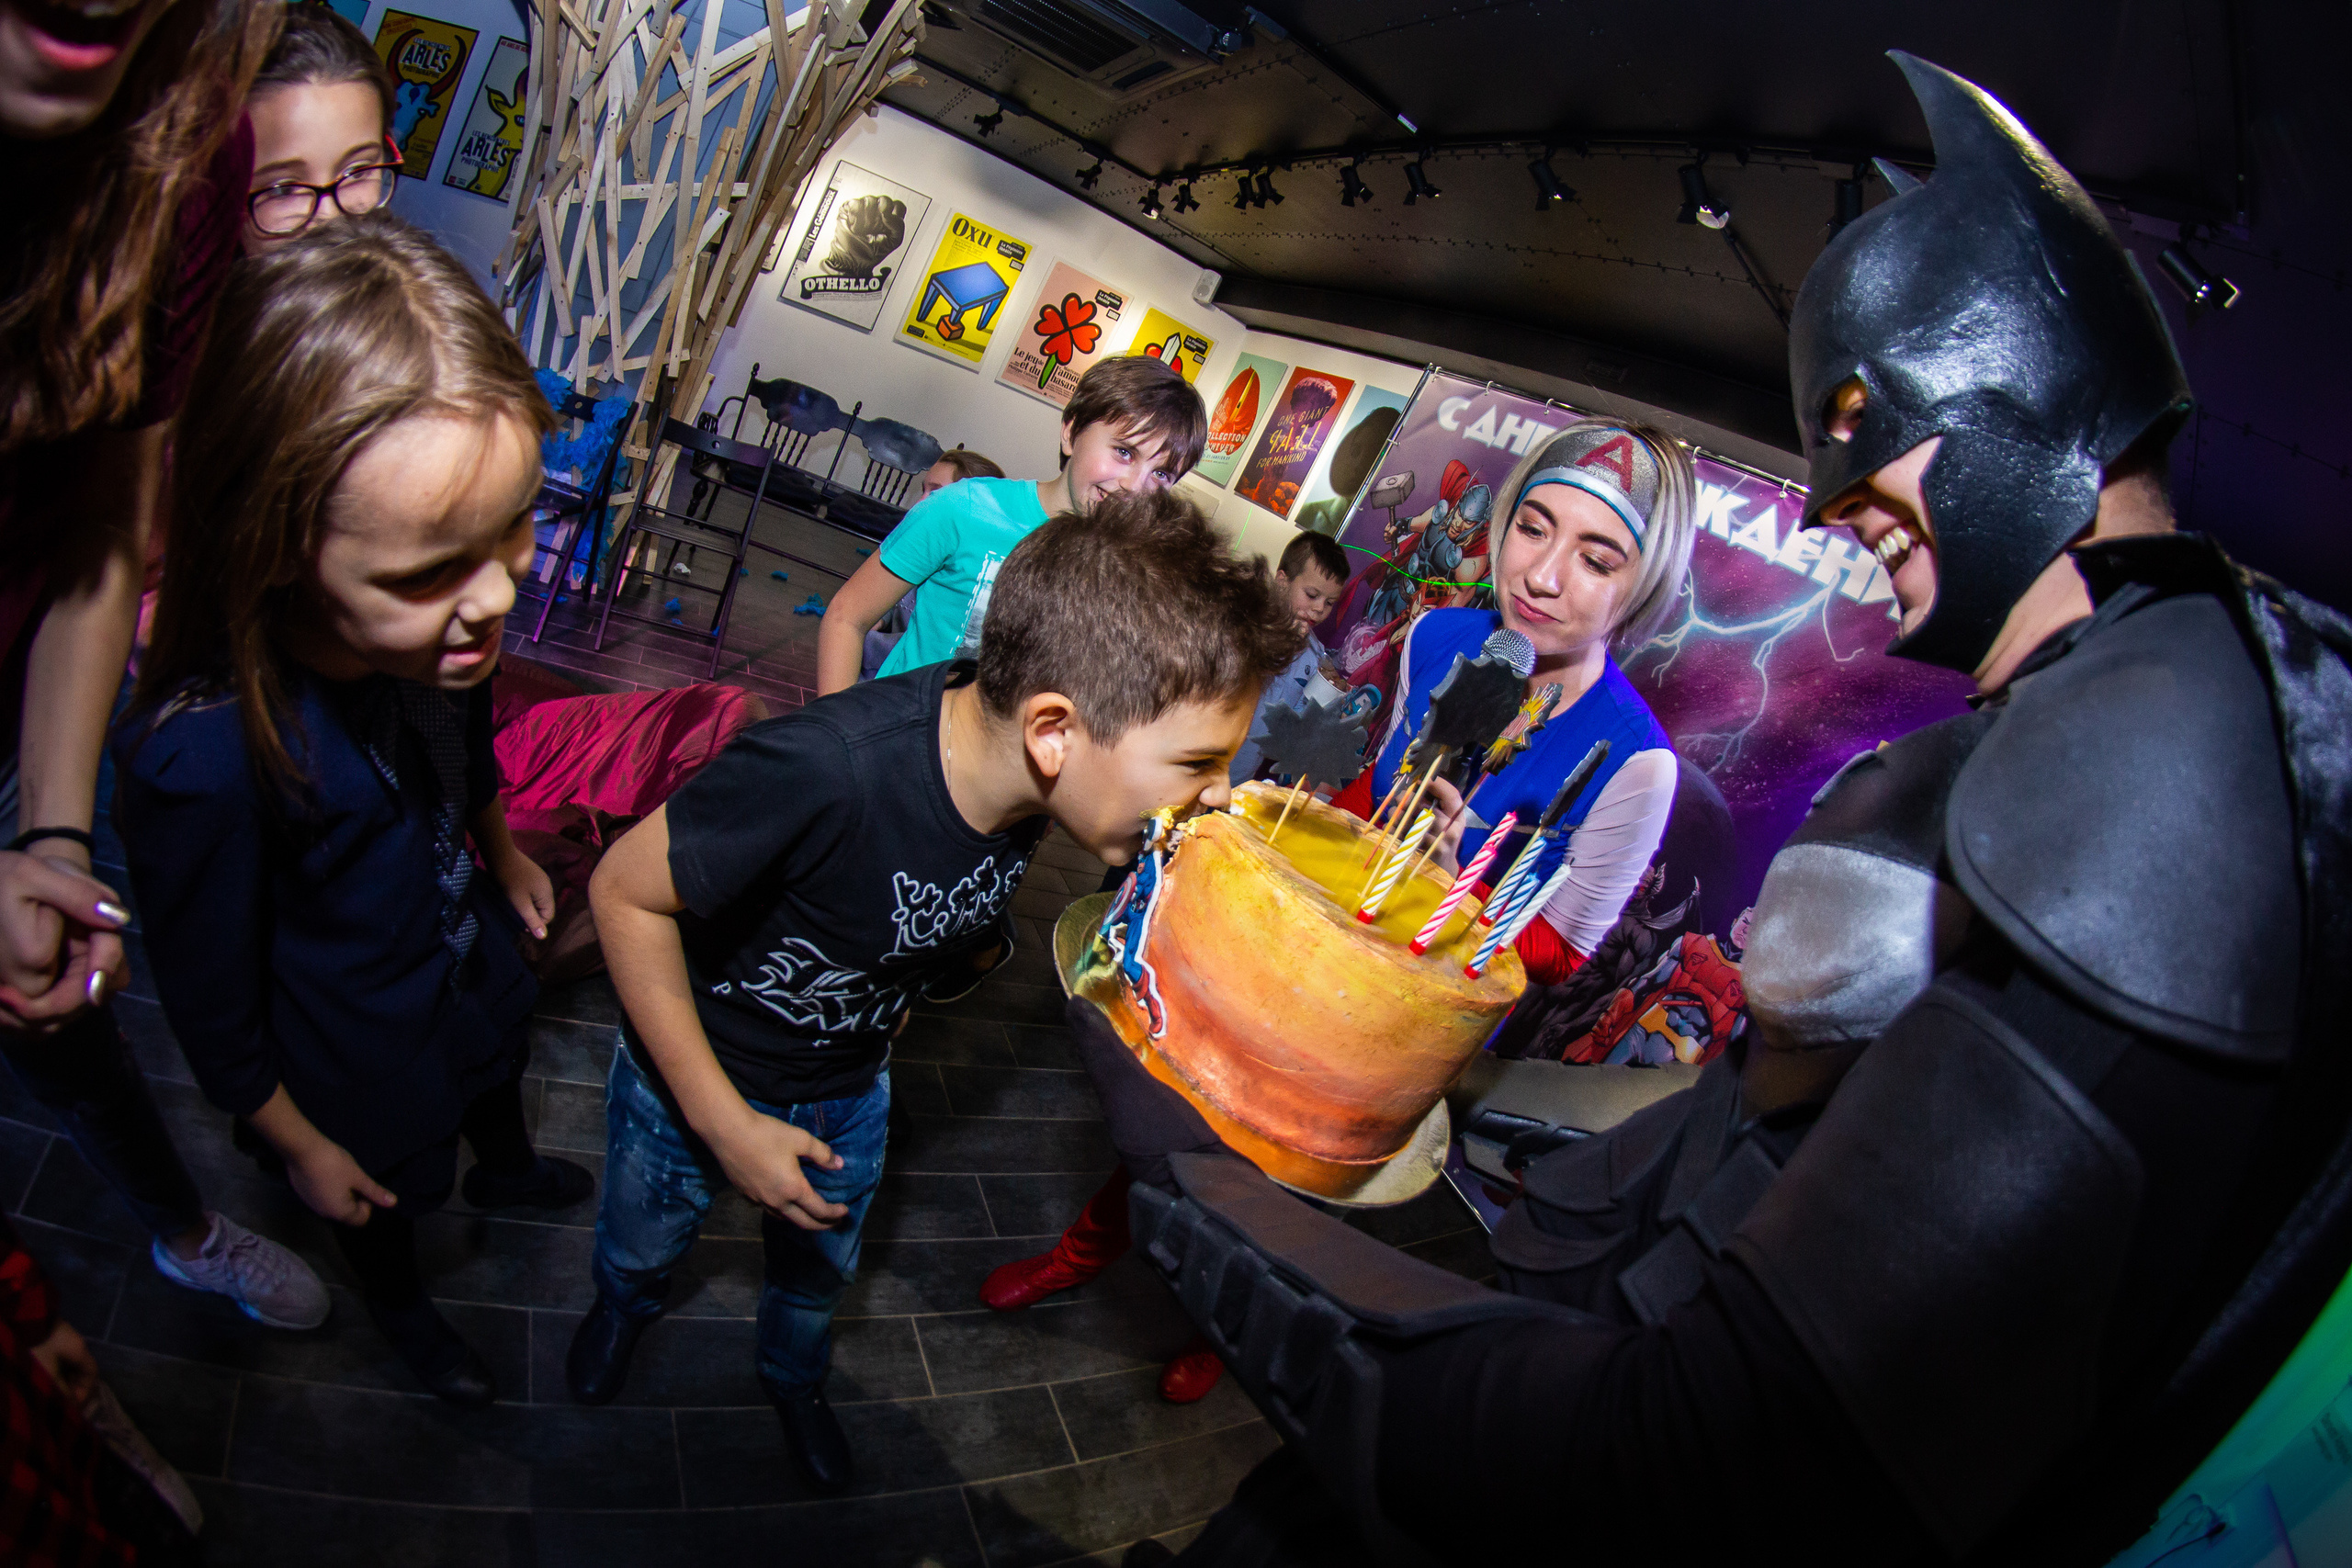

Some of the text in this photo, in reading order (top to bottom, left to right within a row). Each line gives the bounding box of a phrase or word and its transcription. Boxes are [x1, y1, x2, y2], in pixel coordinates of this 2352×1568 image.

[401, 44, 451, 73] ARLES
[460, 136, 511, 167] ARLES
[805, 277, 880, 291] OTHELLO
[1014, 346, 1025, 358] Le
[1024, 352, 1039, 365] jeu
[1020, 361, 1030, 370] et
[1029, 364, 1041, 376] du
[1277, 405, 1329, 426] ONE GIANT
[1438, 395, 1473, 432] С
[1207, 432, 1247, 443] OLLECTION
[1256, 450, 1306, 468] FOR MANKIND
